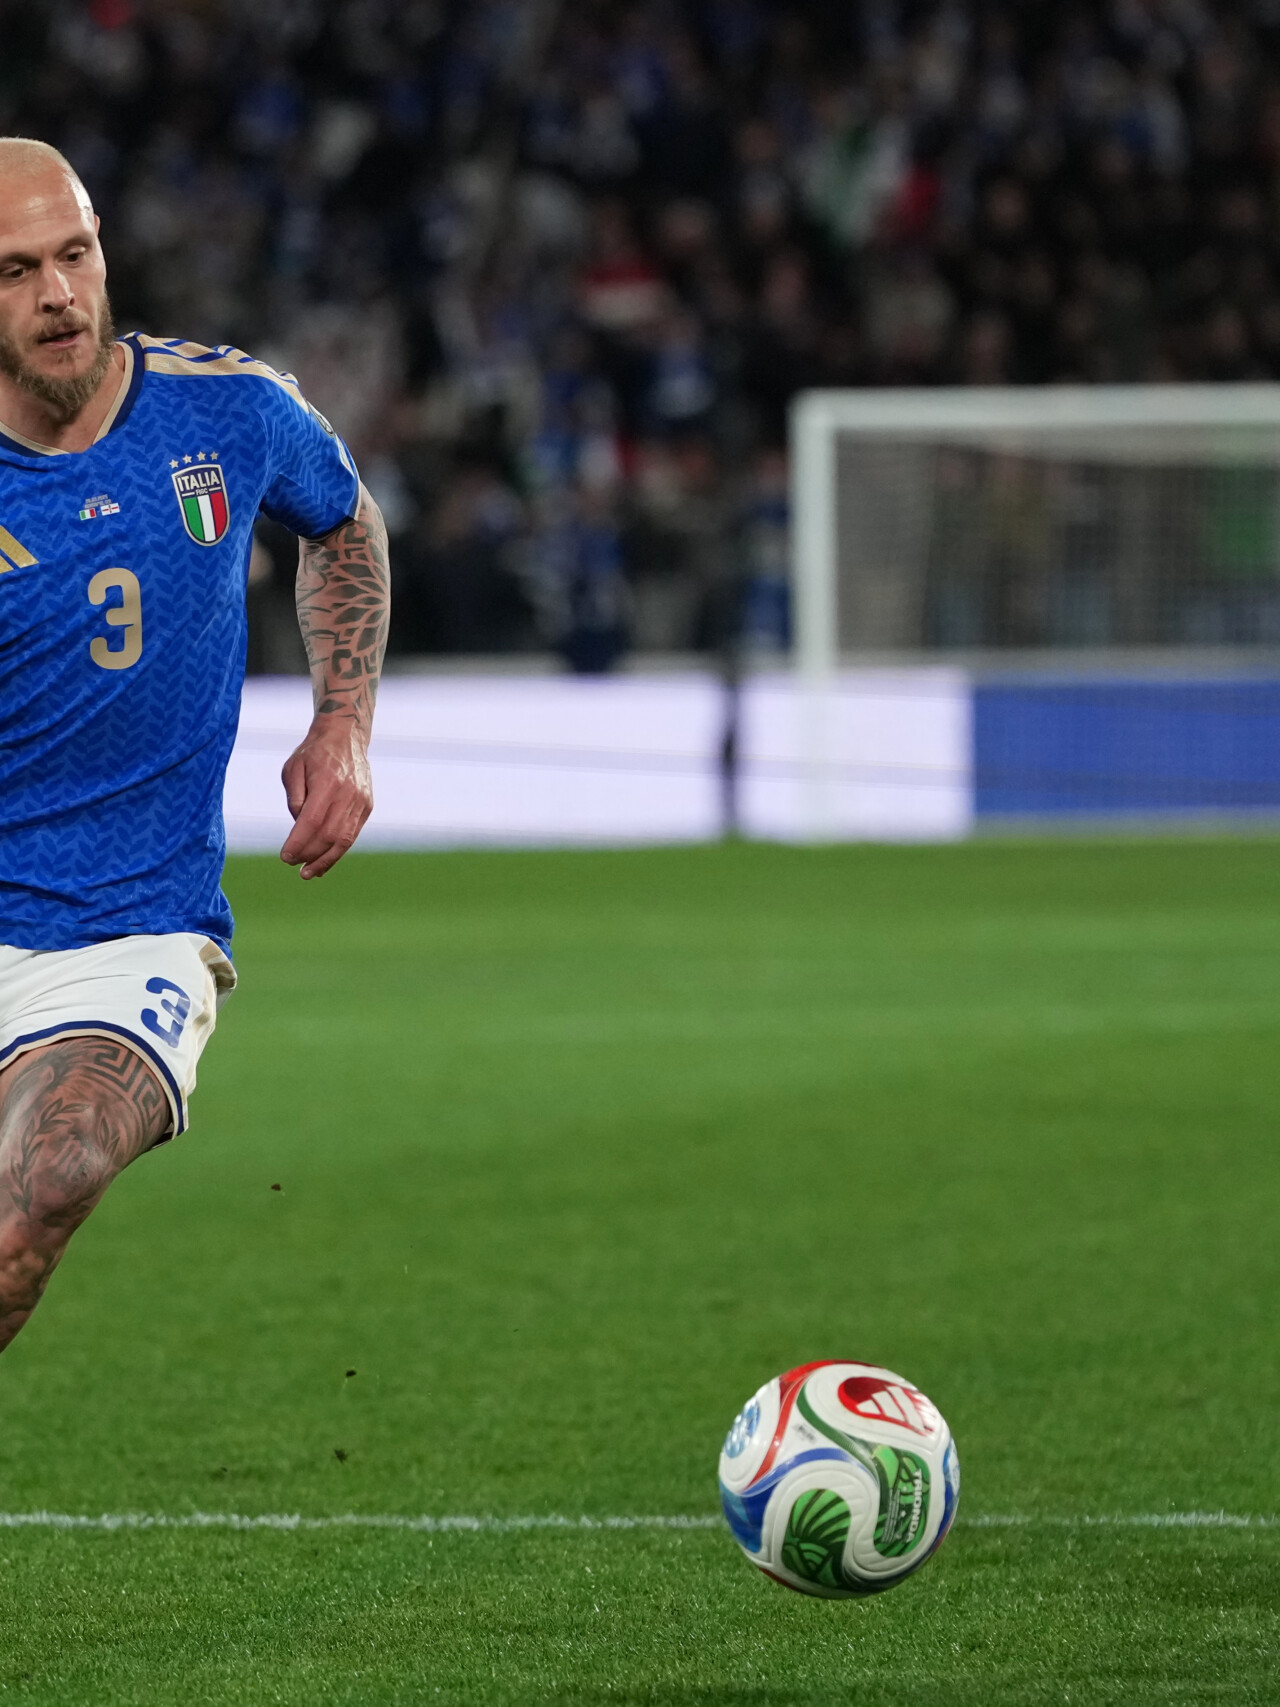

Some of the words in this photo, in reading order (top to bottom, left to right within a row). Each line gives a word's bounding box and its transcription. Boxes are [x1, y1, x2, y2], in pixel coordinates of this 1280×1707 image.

[176, 470, 220, 492] ITALIA
[195, 488, 209, 496] FIGC
[87, 567, 143, 670] 3
[140, 976, 191, 1049] 3
[905, 1467, 923, 1543] TRIONDA
